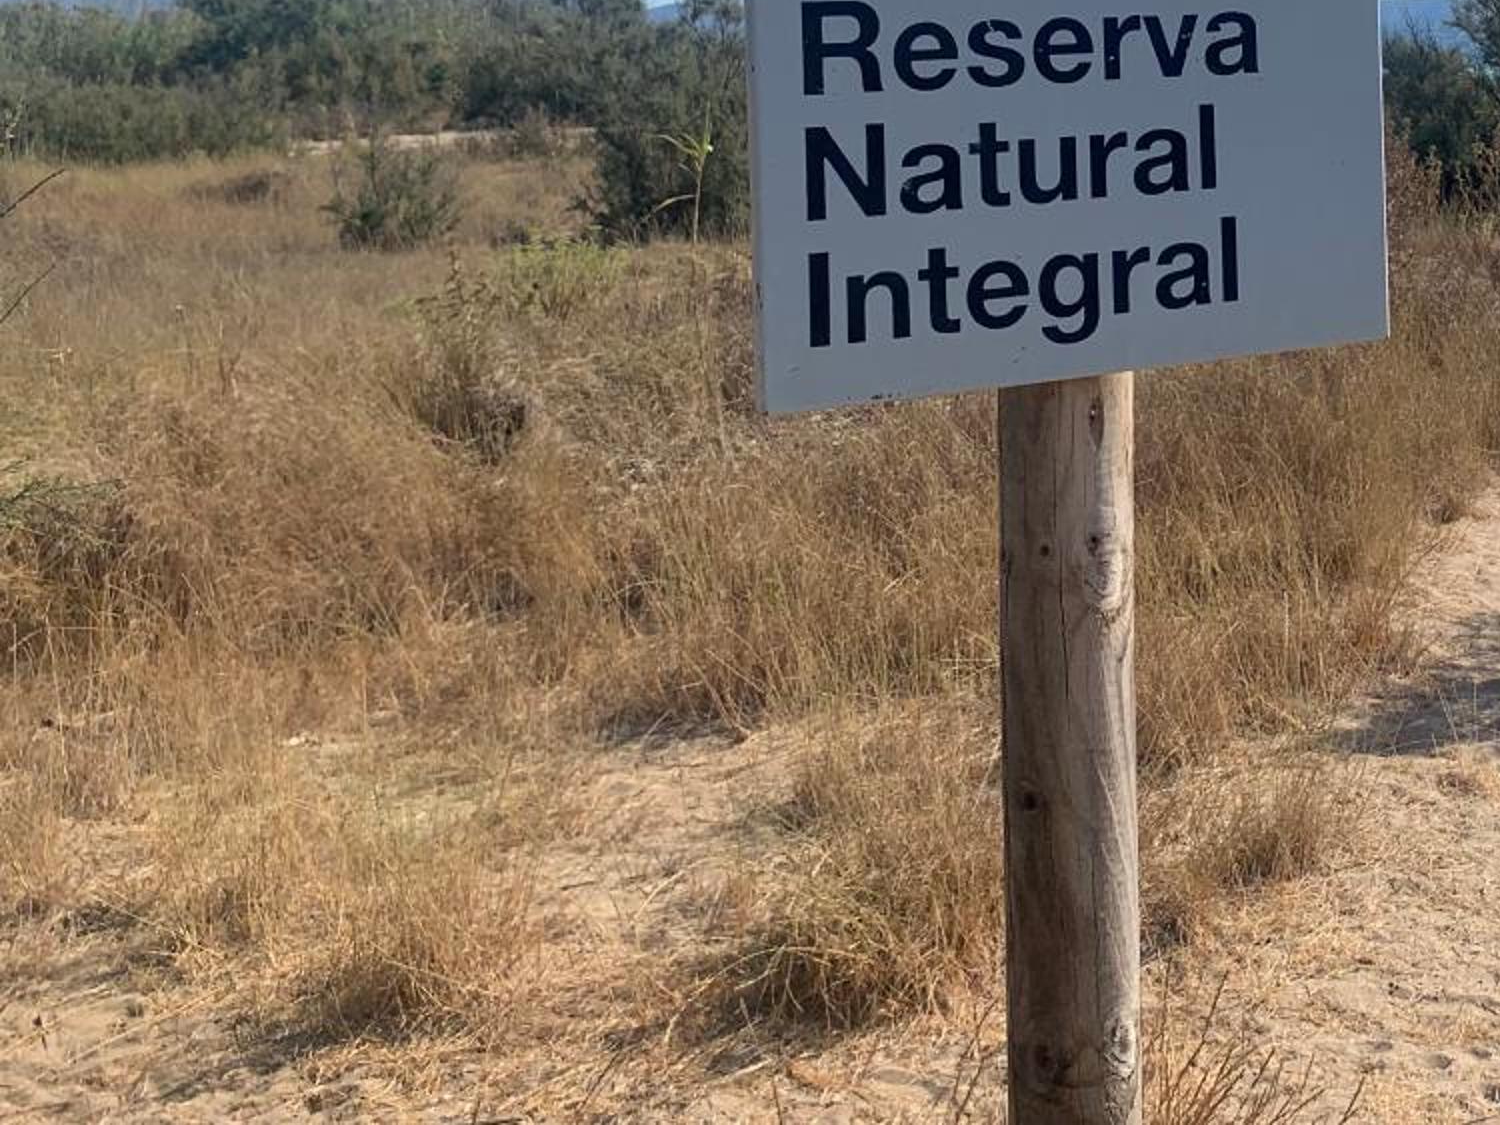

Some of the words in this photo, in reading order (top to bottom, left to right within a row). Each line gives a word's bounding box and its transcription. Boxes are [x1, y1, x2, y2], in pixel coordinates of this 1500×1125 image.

[800, 0, 1259, 96] Reserva
[804, 103, 1217, 222] Natural
[807, 215, 1240, 348] Integral
